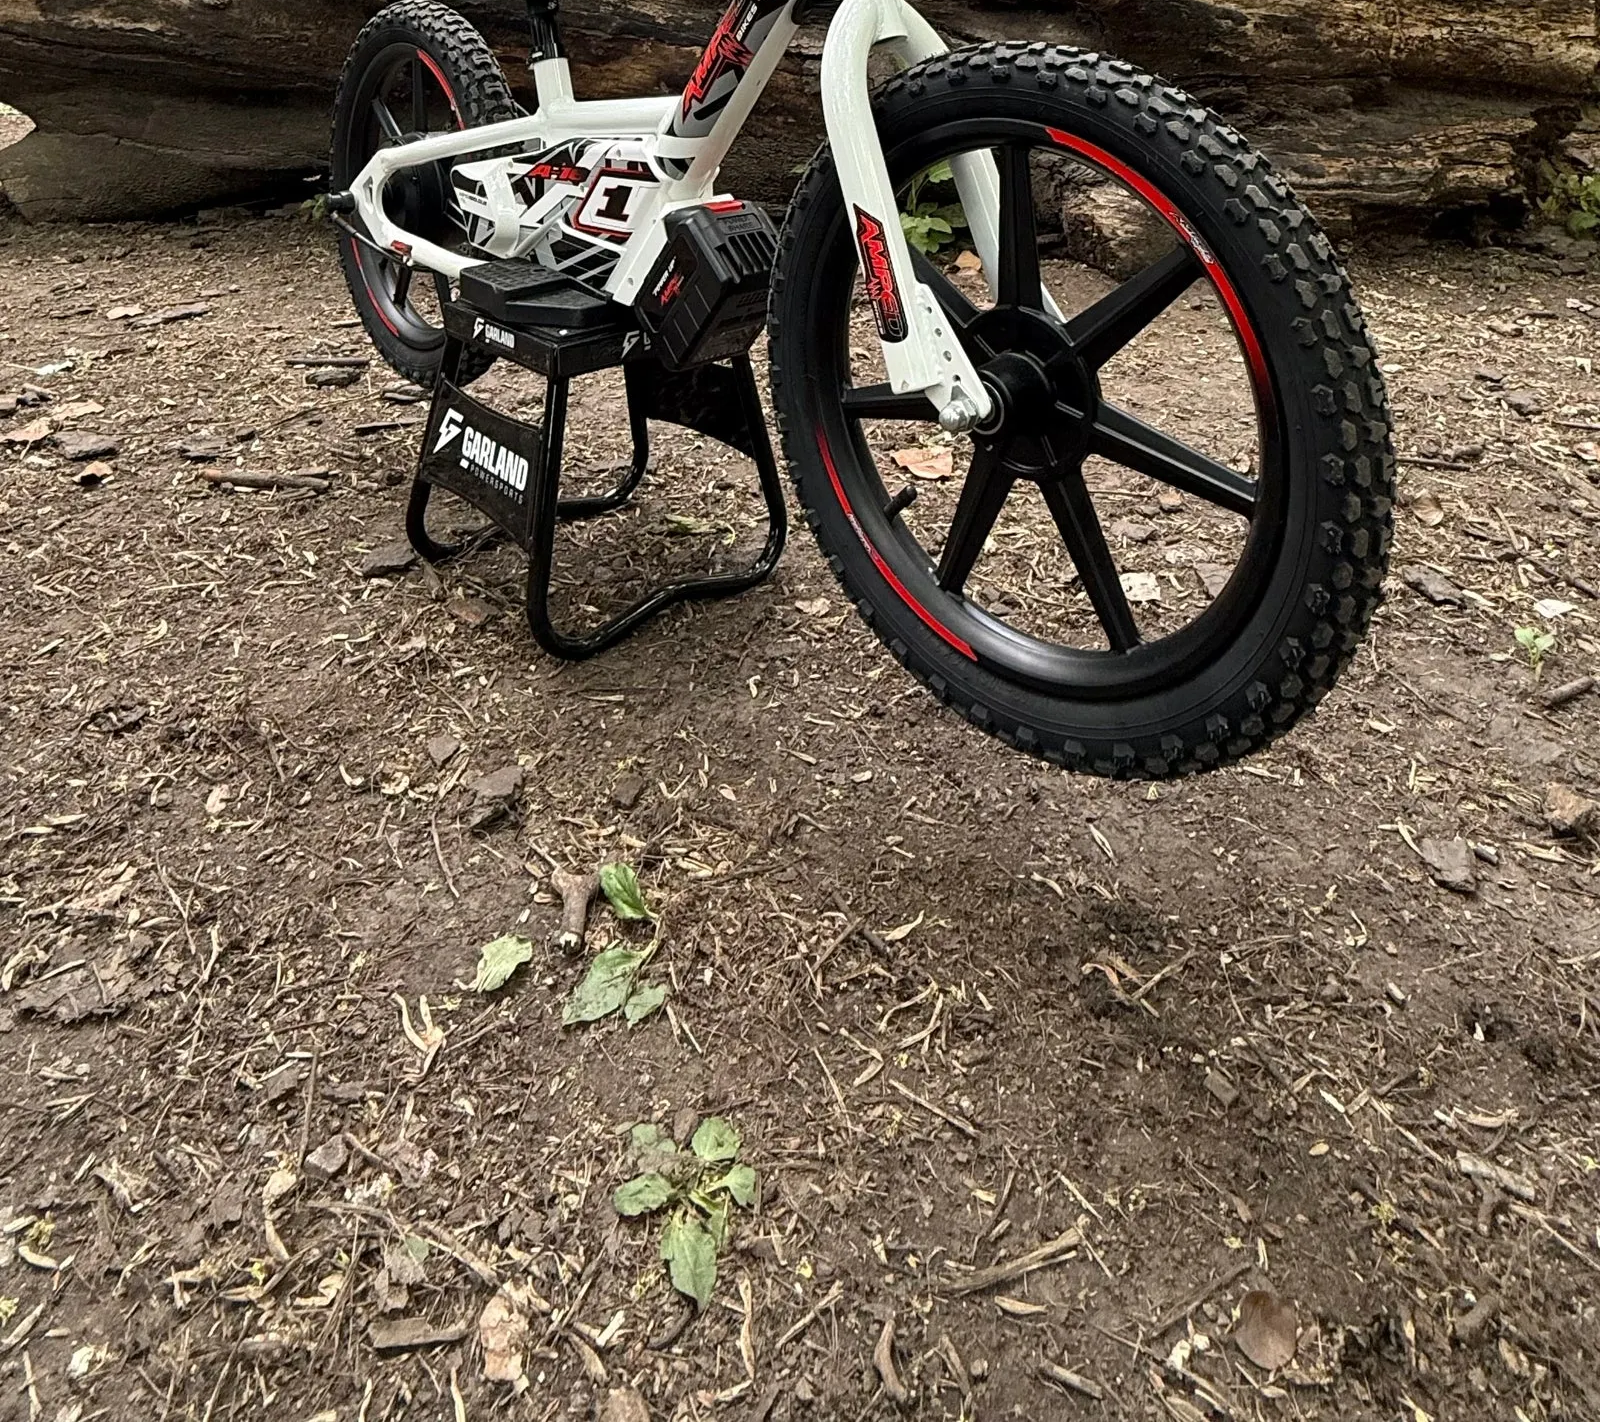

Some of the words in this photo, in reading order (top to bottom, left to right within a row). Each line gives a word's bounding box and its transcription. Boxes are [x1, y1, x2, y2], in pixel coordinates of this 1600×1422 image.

[735, 3, 759, 42] BIKES
[596, 184, 634, 223] 1
[859, 213, 904, 338] AMPED
[485, 323, 516, 349] GARLAND
[461, 425, 529, 492] GARLAND
[469, 463, 524, 506] POWERSPORTS
